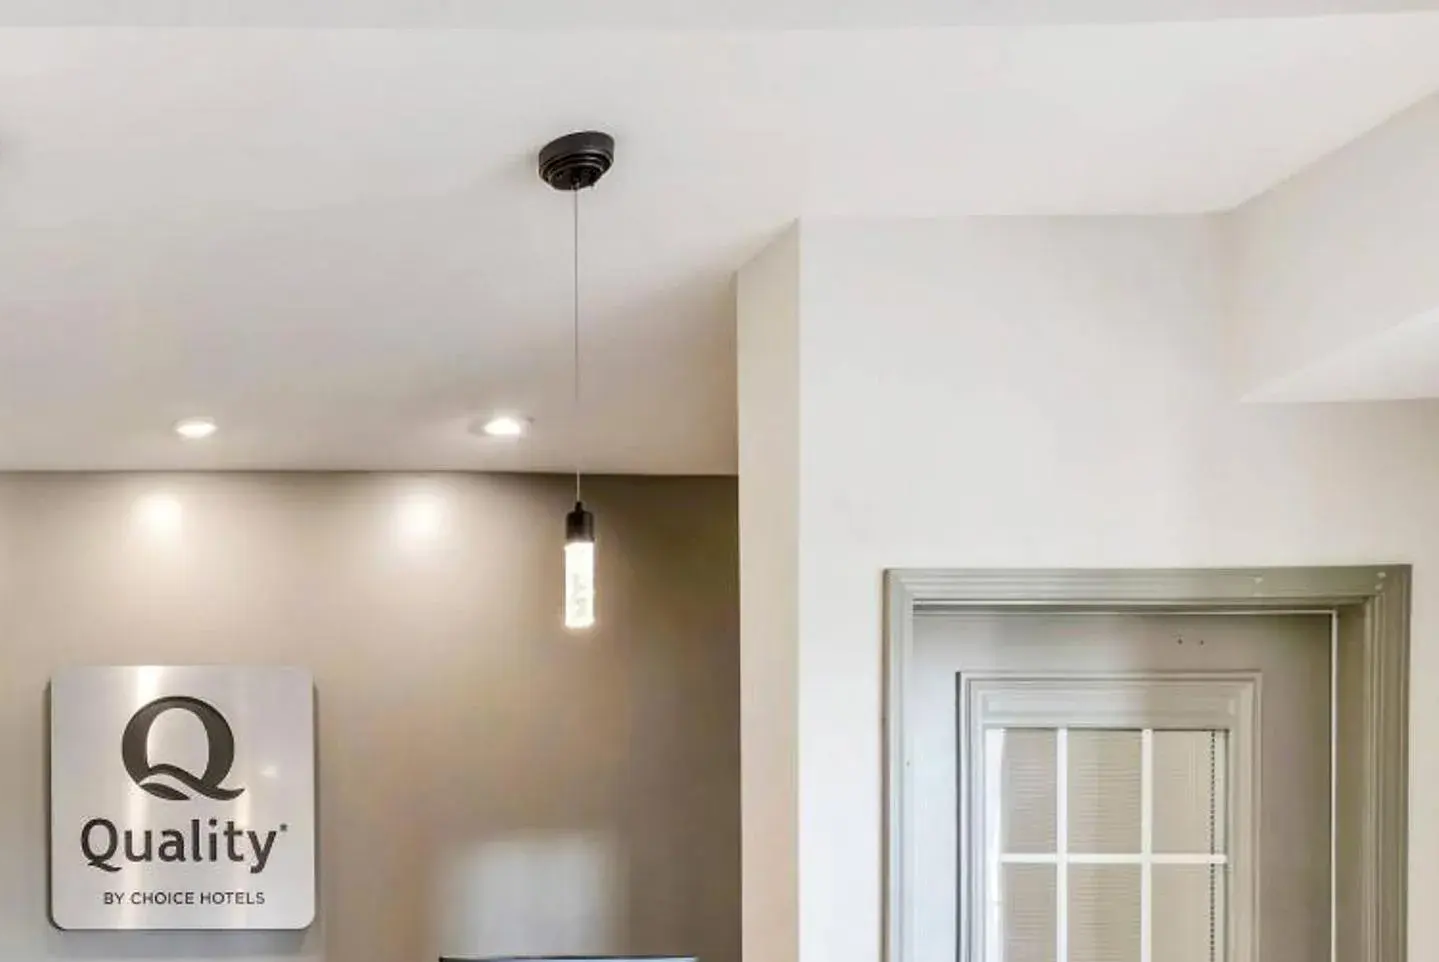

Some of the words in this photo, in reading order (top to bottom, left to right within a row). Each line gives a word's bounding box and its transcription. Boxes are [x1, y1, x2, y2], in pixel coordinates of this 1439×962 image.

[122, 695, 245, 800] Q
[104, 892, 125, 905] BY
[131, 892, 194, 905] CHOICE
[200, 892, 266, 905] HOTELS
